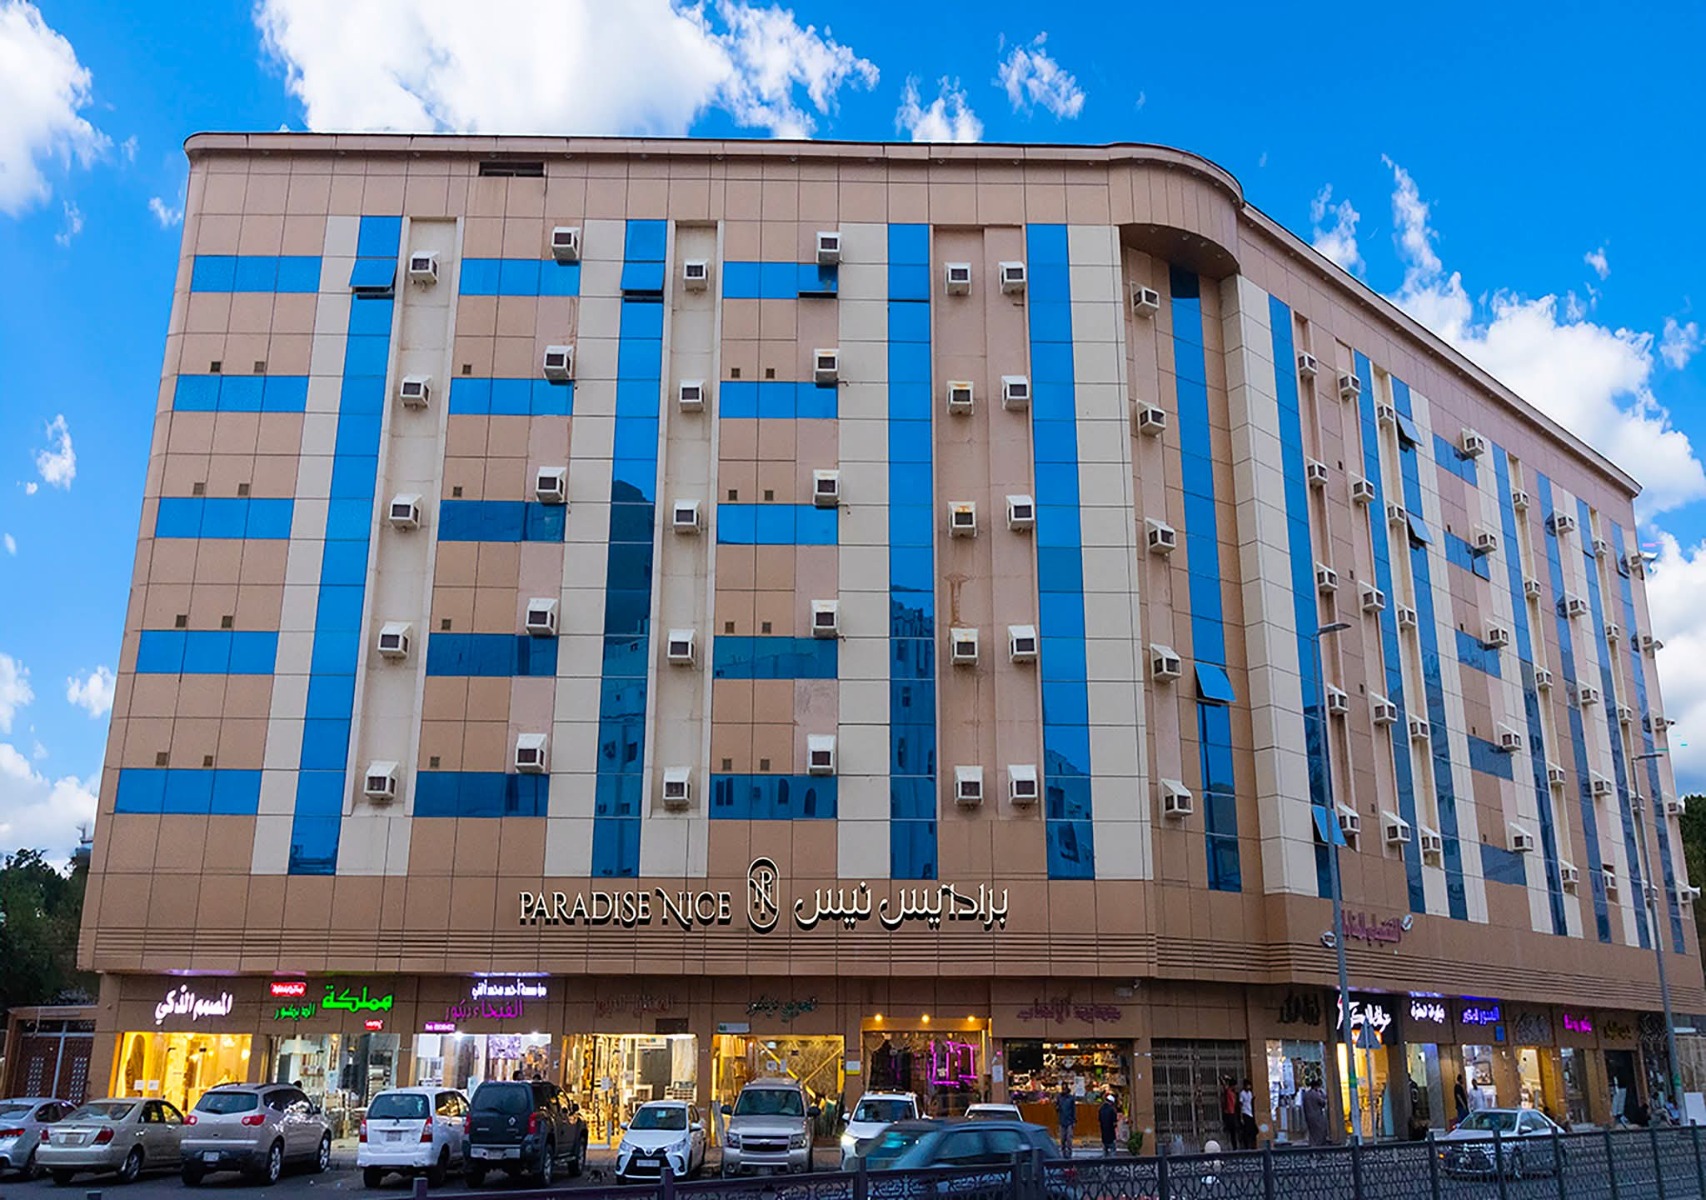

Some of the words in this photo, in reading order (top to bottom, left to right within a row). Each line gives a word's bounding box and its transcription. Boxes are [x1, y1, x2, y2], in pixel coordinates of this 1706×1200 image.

[519, 891, 652, 923] PARADISE
[655, 887, 732, 928] NICE
[794, 880, 873, 926] نيس
[879, 883, 1009, 926] برادايس
[155, 984, 195, 1026] الذكي
[193, 991, 234, 1021] المصمم
[274, 1001, 317, 1021] الديكور
[321, 984, 394, 1012] مملكة
[444, 998, 473, 1022] ديكور
[473, 999, 523, 1021] الفيحاء
